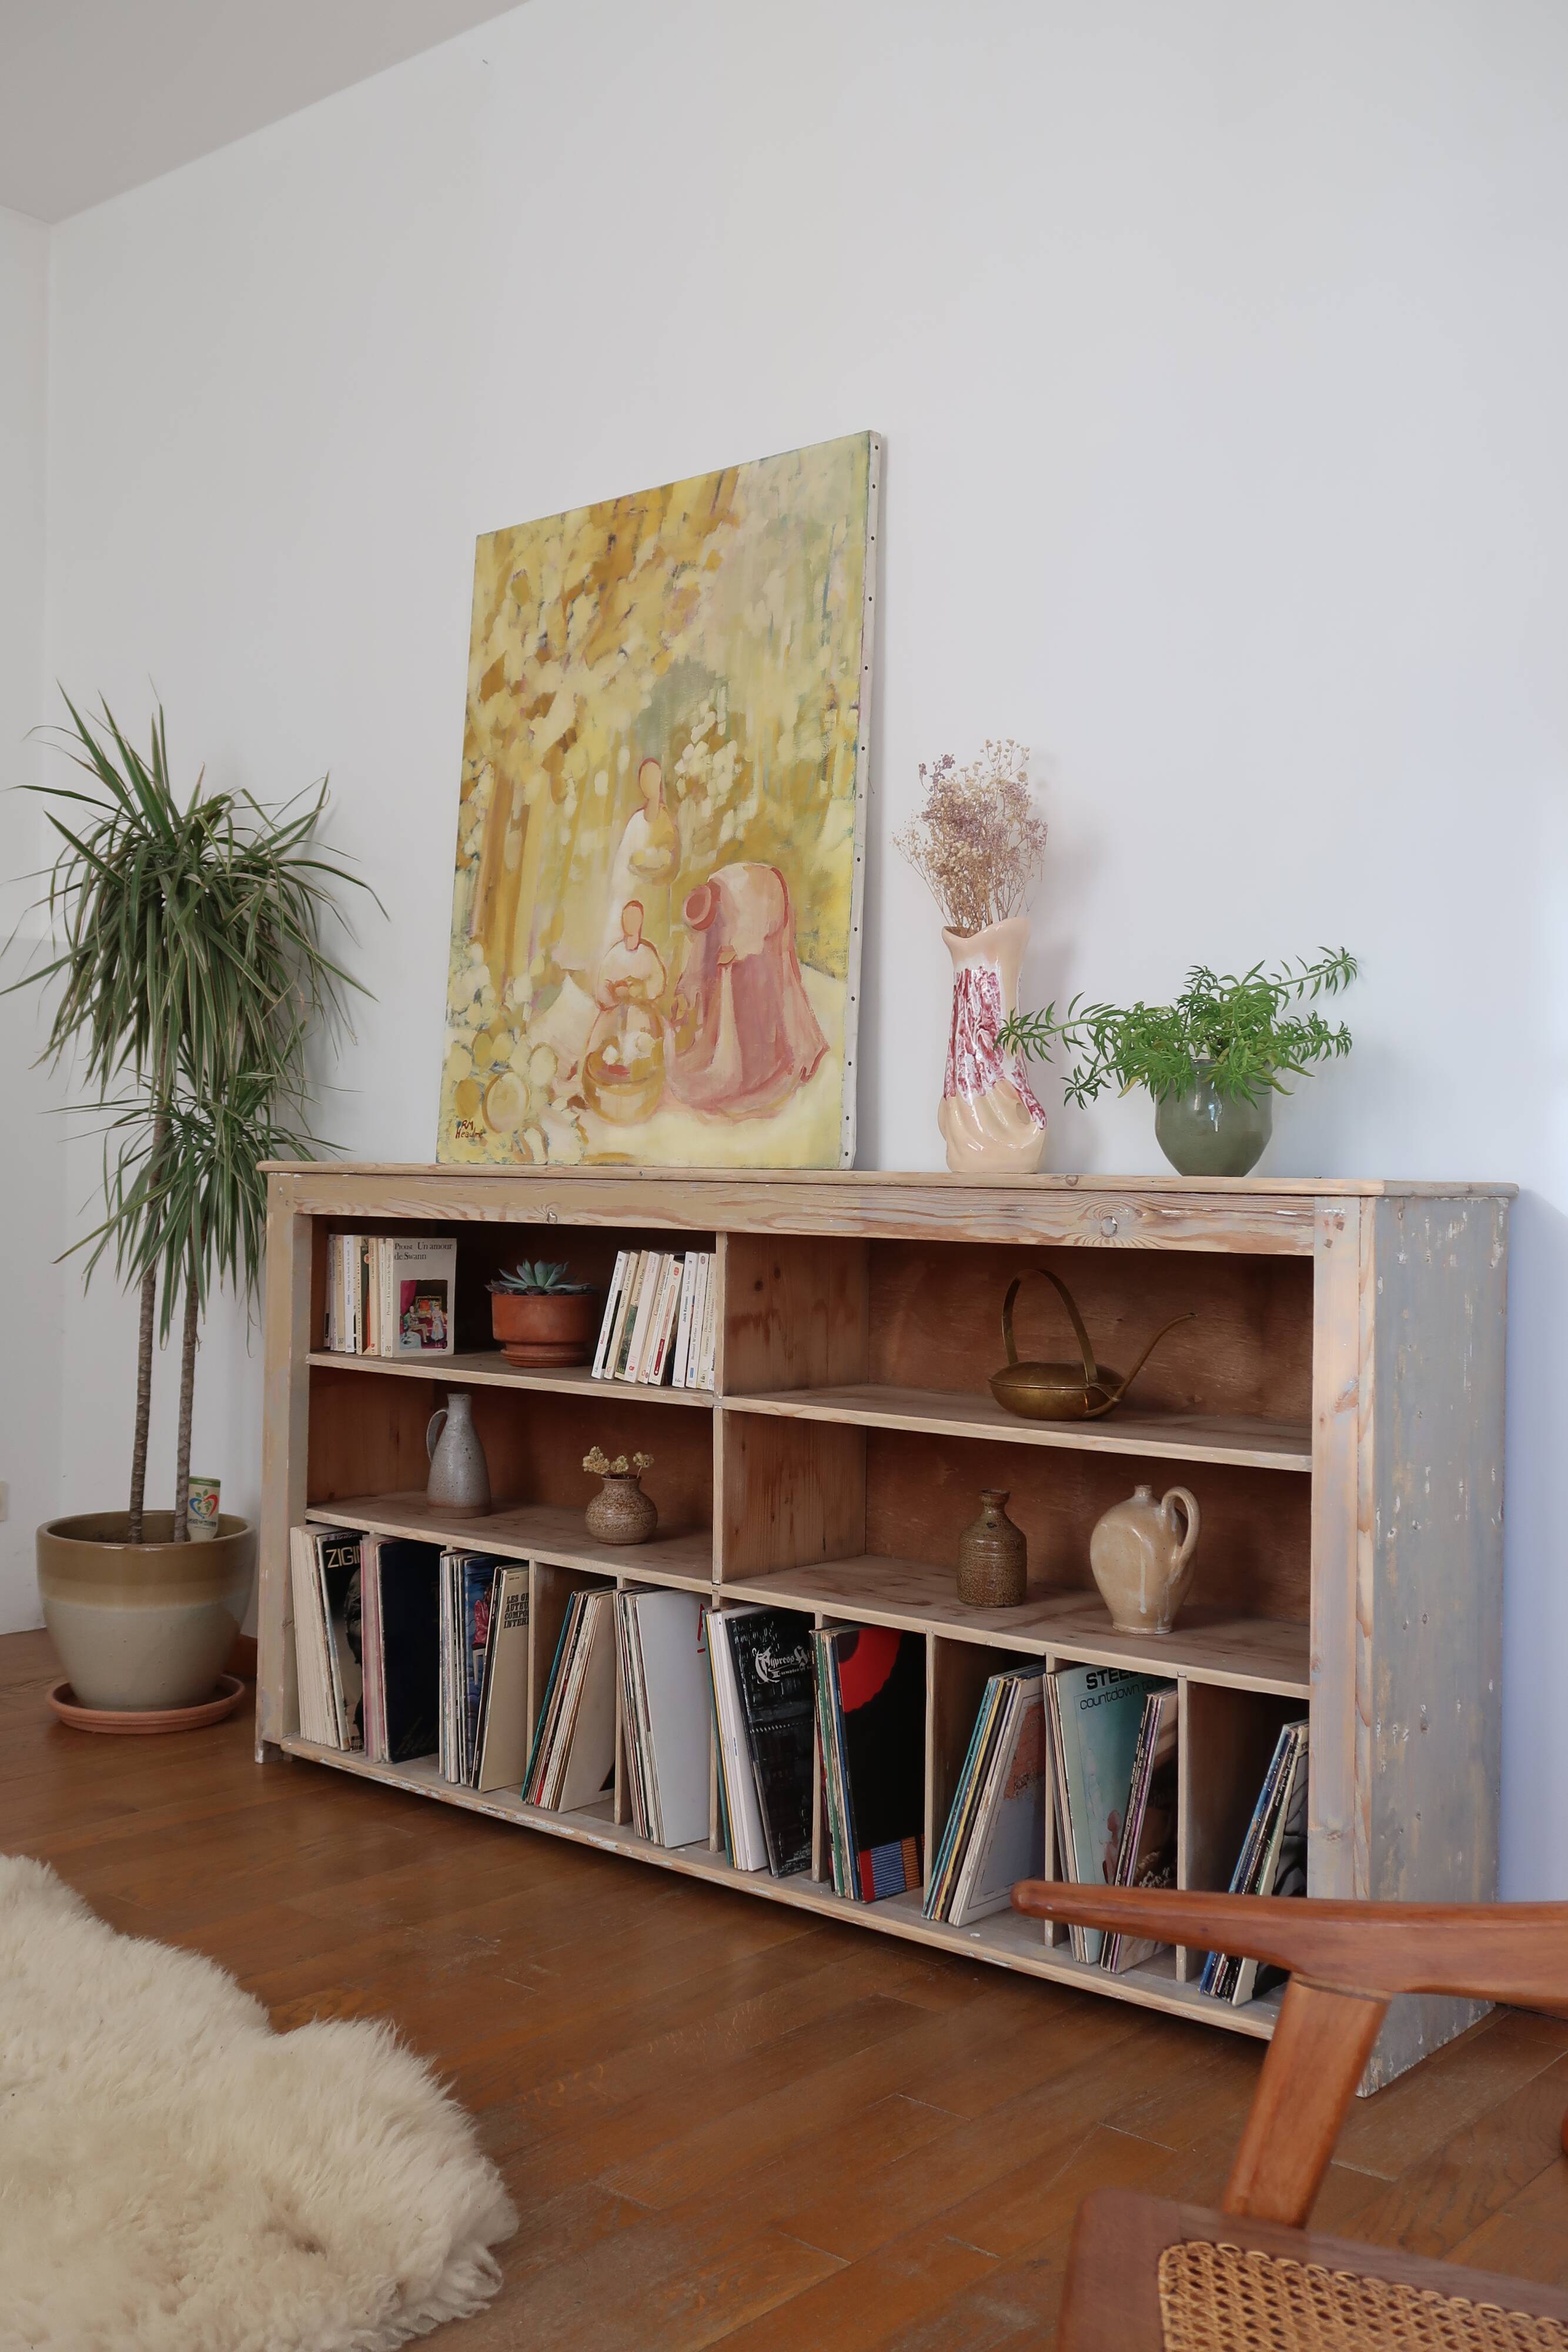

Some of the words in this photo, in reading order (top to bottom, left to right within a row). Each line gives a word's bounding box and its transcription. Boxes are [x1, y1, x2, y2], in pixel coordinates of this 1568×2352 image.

[417, 1242, 428, 1250] Un
[394, 1252, 403, 1260] de
[507, 1595, 519, 1604] LES
[1080, 1683, 1139, 1710] countdown
[1142, 1679, 1153, 1691] to
